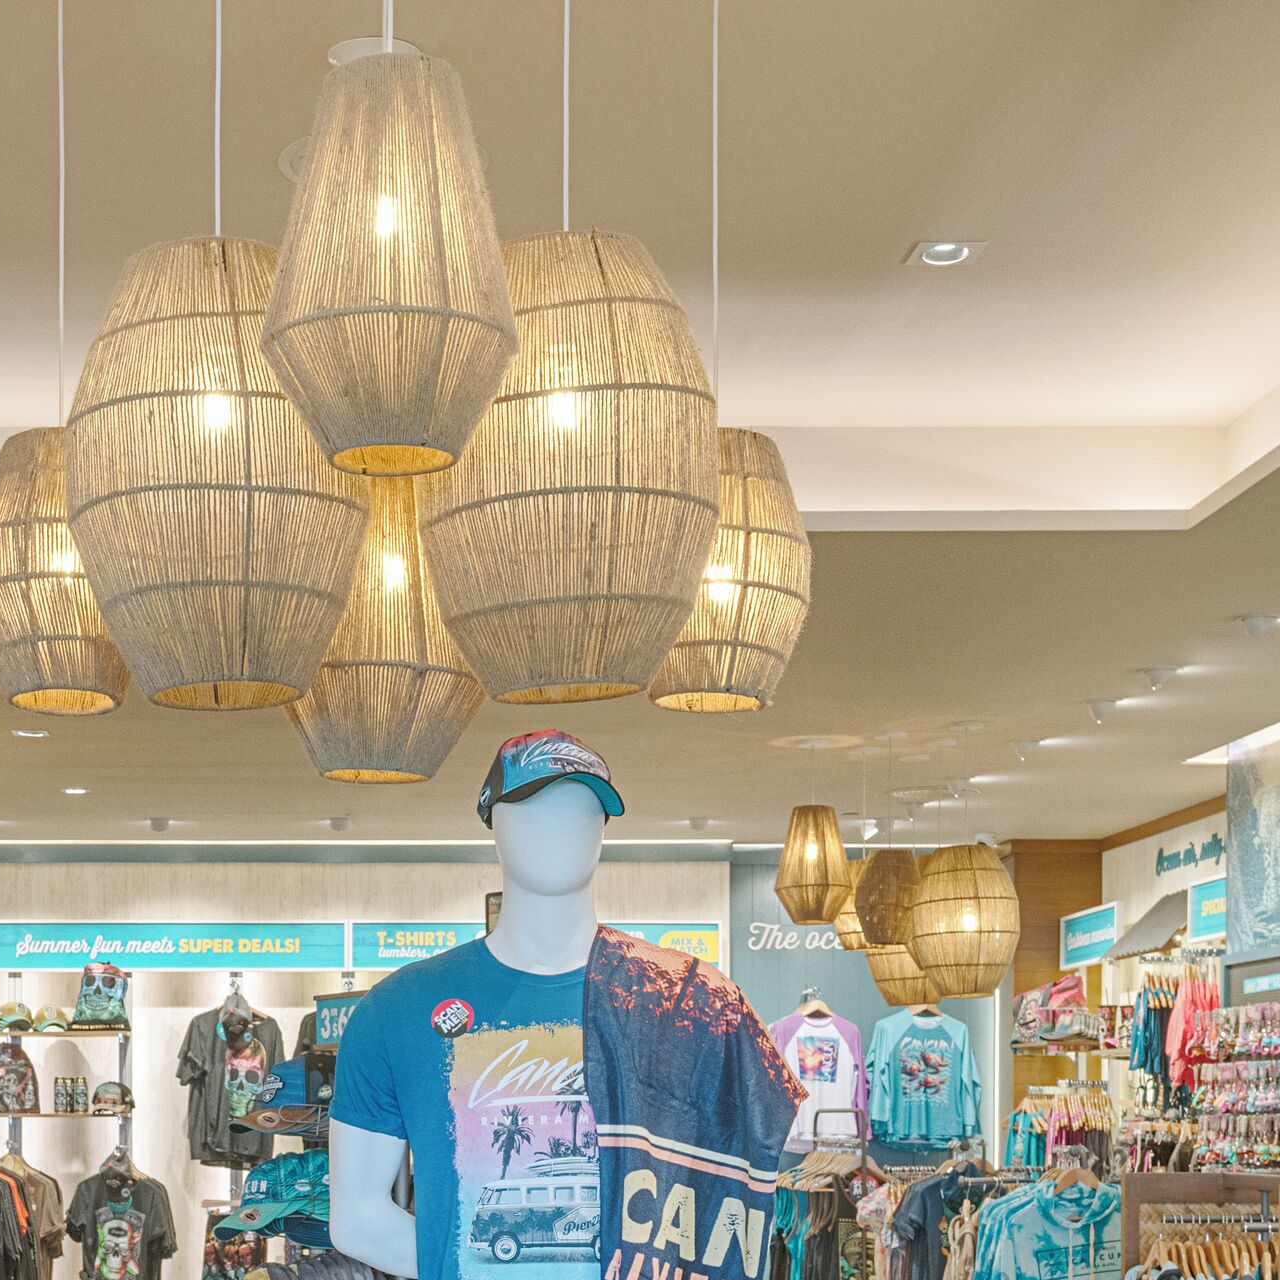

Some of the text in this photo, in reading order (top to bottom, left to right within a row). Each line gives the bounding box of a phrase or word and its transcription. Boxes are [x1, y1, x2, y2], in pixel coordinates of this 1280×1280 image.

[16, 934, 301, 960] Summer fun meets SUPER DEALS!
[377, 930, 458, 947] T-SHIRTS
[670, 937, 705, 947] MIX &
[747, 921, 800, 952] The
[320, 1007, 331, 1039] 3
[434, 1001, 463, 1025] SCAN
[440, 1014, 461, 1034] ME
[469, 1039, 585, 1109] Canc
[481, 1114, 563, 1127] RIVIERA
[622, 1169, 765, 1279] CAN
[1072, 1252, 1121, 1266] CACUN
